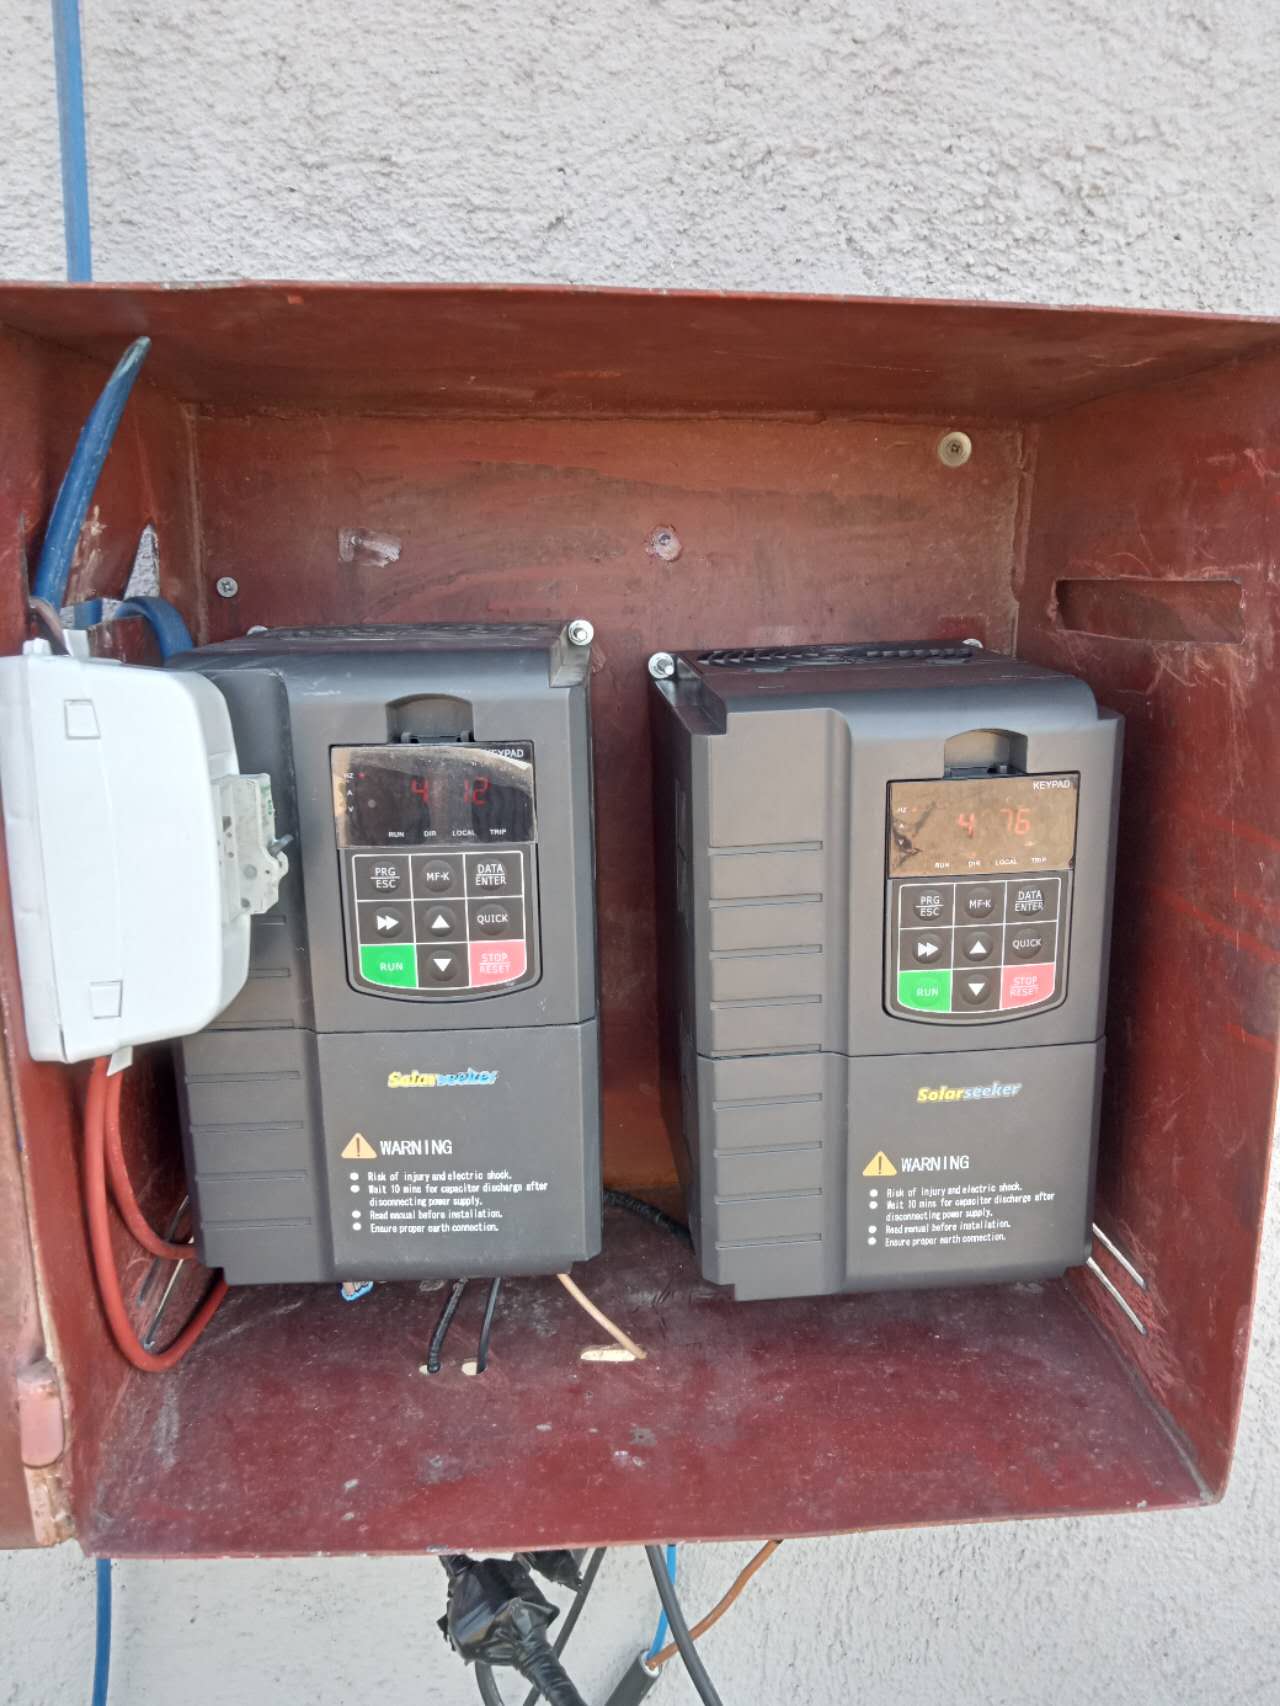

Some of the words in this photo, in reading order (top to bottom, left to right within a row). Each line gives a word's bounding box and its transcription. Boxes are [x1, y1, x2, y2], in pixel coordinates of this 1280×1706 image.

[1032, 780, 1071, 791] KEYPAD
[388, 831, 405, 839] RUN
[423, 830, 437, 838] DIR
[452, 829, 476, 837] LOCAL
[489, 828, 506, 836] TRIP
[995, 857, 1018, 866] LOCAL
[374, 867, 397, 877] PRG
[477, 863, 504, 874] DATA
[375, 879, 397, 889] ESC
[475, 875, 507, 887] ENTER
[1018, 889, 1043, 900] DATA
[920, 895, 941, 906] PRG
[920, 906, 940, 917] ESC
[1014, 901, 1044, 912] ENTER
[476, 914, 509, 924] QUICK
[1012, 938, 1042, 949] QUICK
[480, 953, 508, 964] STOP
[379, 962, 404, 972] RUN
[479, 965, 511, 975] RESET
[1013, 976, 1038, 986] STOP
[916, 987, 939, 997] RUN
[1009, 986, 1040, 997] RESET
[917, 1081, 1022, 1103] Solarseeker
[379, 1139, 453, 1156] WARNING
[901, 1155, 970, 1172] WARNING
[367, 1171, 387, 1182] Risk
[389, 1171, 400, 1181] of
[403, 1171, 430, 1183] injury
[431, 1171, 446, 1181] and
[447, 1170, 484, 1181] electric
[486, 1169, 513, 1180] shock.
[368, 1184, 388, 1195] Wait
[391, 1184, 401, 1194] 10
[403, 1184, 422, 1194] mins
[425, 1183, 438, 1194] for
[440, 1183, 480, 1194] capacitor
[482, 1182, 523, 1193] discharge
[526, 1180, 549, 1192] after
[886, 1187, 904, 1198] Risk
[907, 1187, 917, 1197] of
[920, 1185, 946, 1197] injury
[947, 1185, 961, 1195] and
[962, 1184, 996, 1194] electric
[999, 1181, 1023, 1192] shock.
[369, 1197, 427, 1208] disconnecting
[428, 1199, 451, 1208] power
[453, 1195, 484, 1208] supply.
[886, 1199, 904, 1210] Wait
[908, 1199, 917, 1209] 10
[919, 1198, 937, 1208] mins
[940, 1196, 953, 1207] for
[955, 1195, 992, 1206] capacitor
[994, 1193, 1032, 1204] discharge
[1034, 1191, 1056, 1202] after
[369, 1211, 389, 1220] Read
[418, 1209, 446, 1220] before
[449, 1207, 504, 1219] installation.
[885, 1211, 941, 1223] disconnecting
[942, 1210, 964, 1220] power
[966, 1207, 993, 1219] supply.
[370, 1223, 397, 1233] Ensure
[399, 1223, 426, 1234] proper
[427, 1221, 450, 1232] earth
[451, 1221, 500, 1232] connection.
[885, 1224, 903, 1234] Read
[931, 1220, 958, 1232] before
[960, 1218, 1012, 1230] installation.
[885, 1237, 911, 1248] Ensure
[912, 1236, 937, 1247] proper
[940, 1234, 961, 1245] earth
[962, 1231, 1007, 1243] connection.
